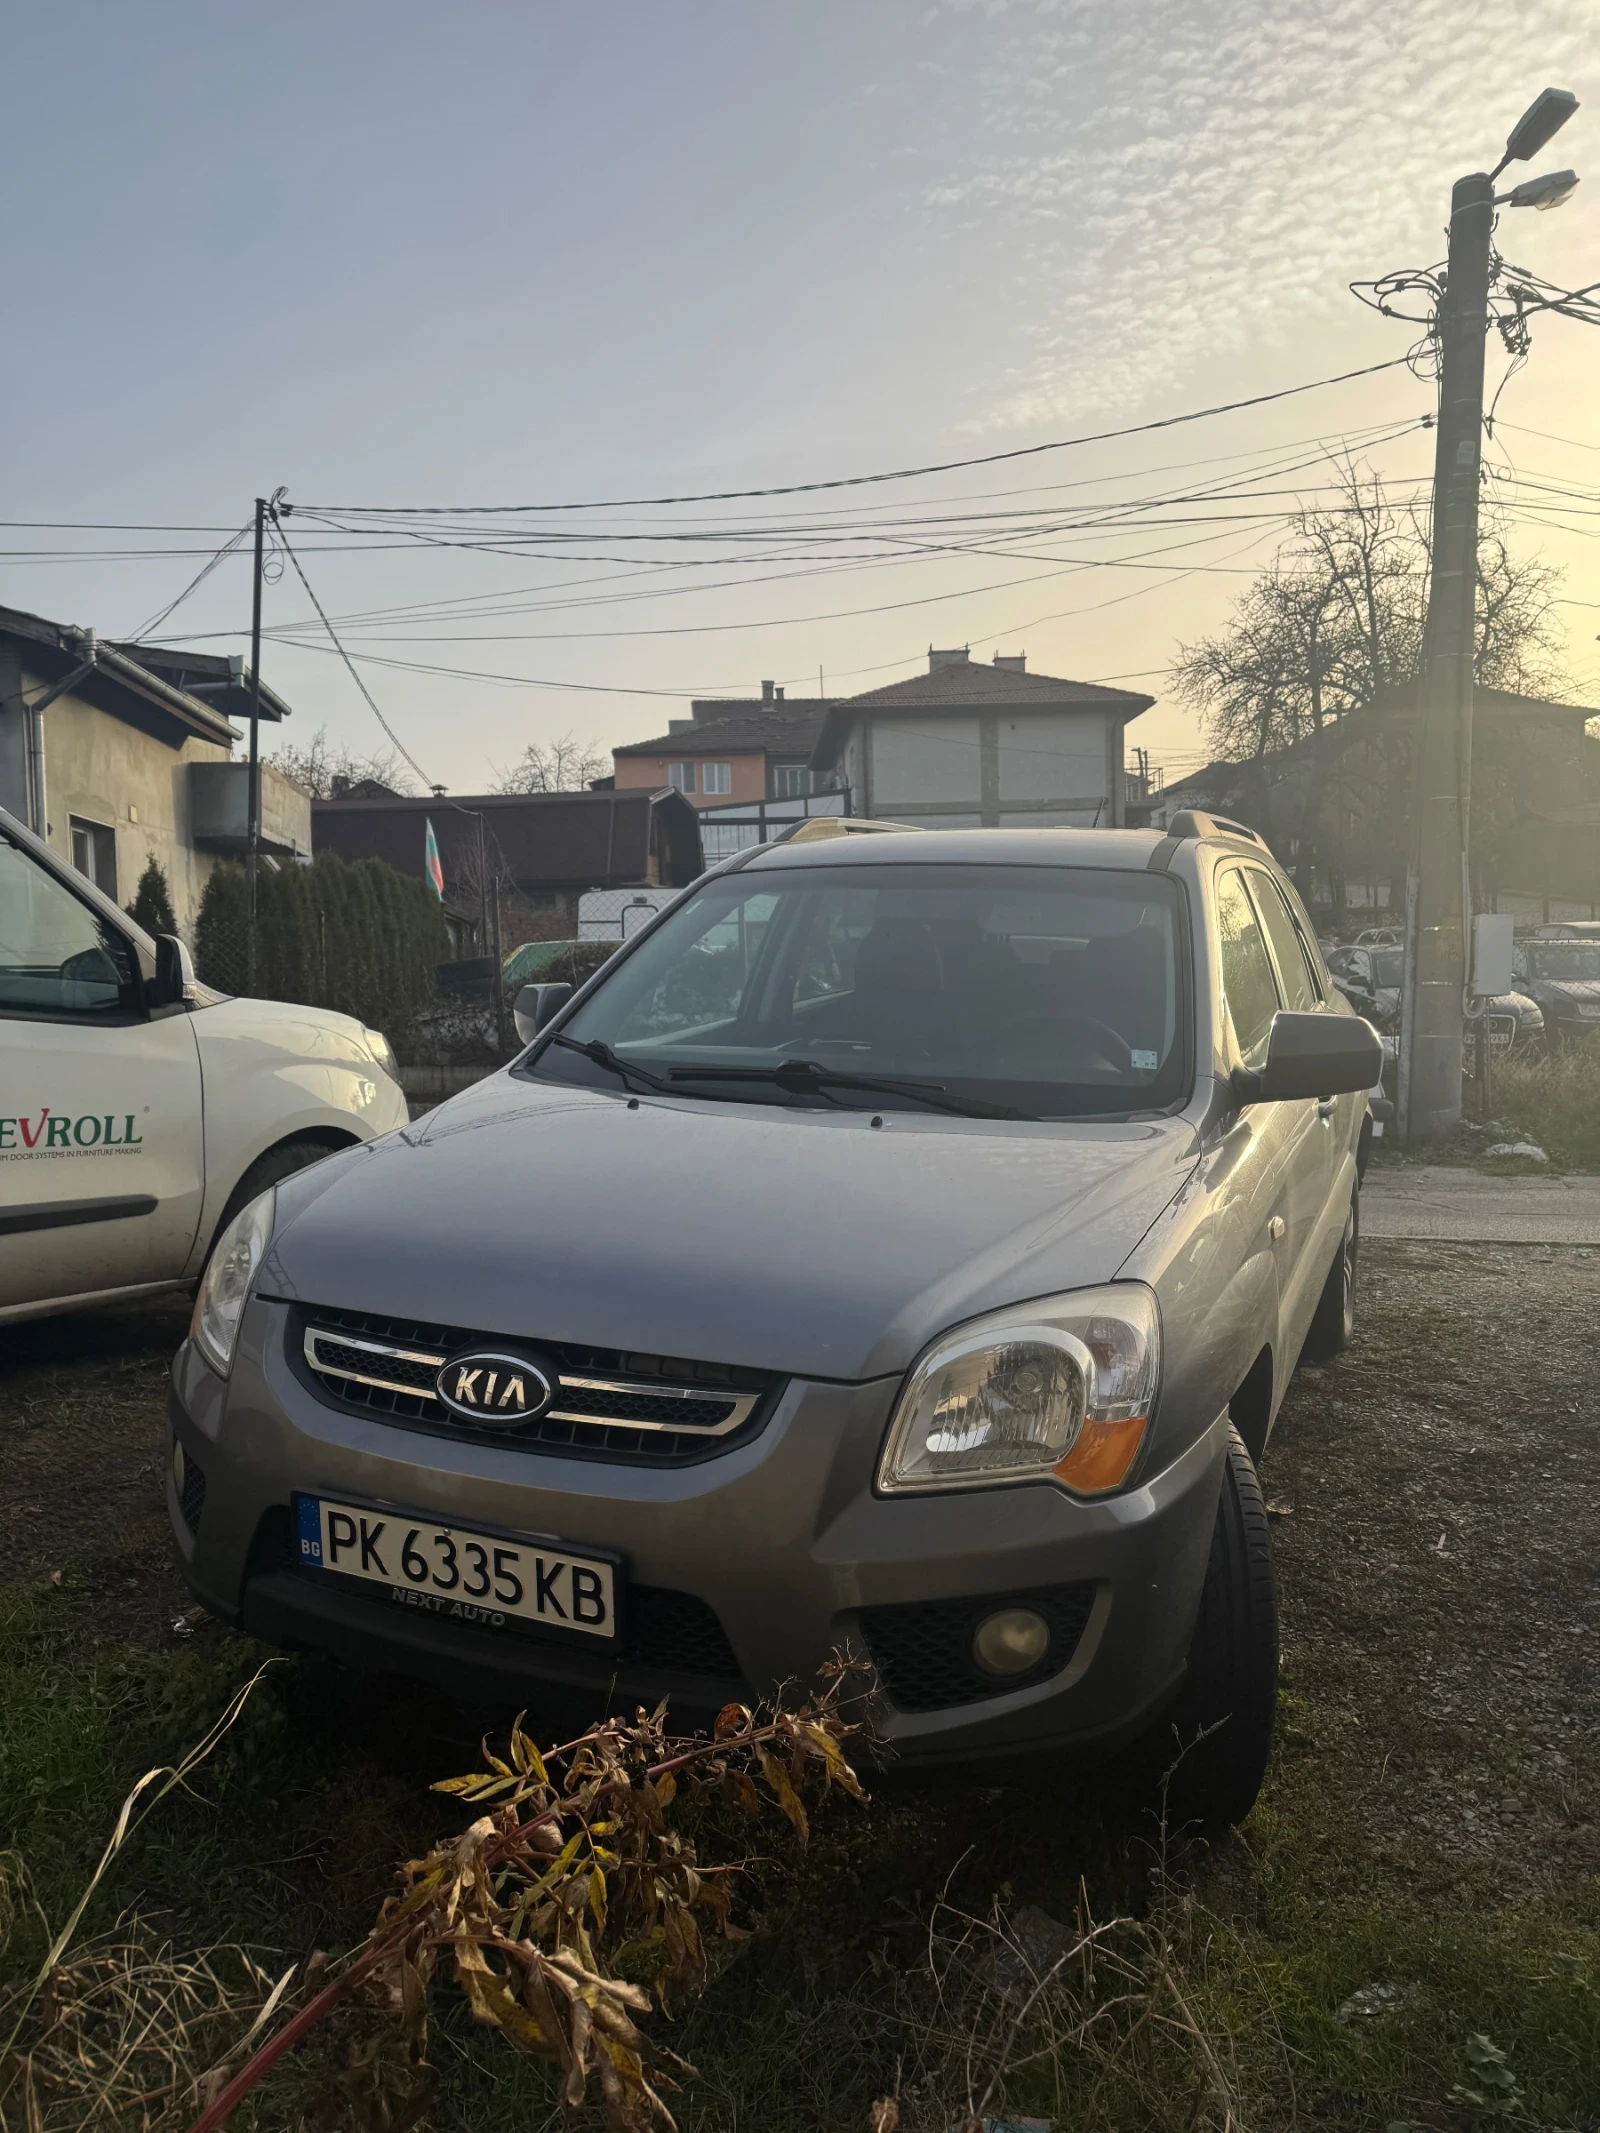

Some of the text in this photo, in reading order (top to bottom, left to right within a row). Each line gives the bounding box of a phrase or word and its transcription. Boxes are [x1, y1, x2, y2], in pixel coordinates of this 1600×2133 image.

[10, 1153, 34, 1161] DOOR
[35, 1151, 65, 1160] SYSTEMS
[76, 1148, 114, 1157] FURNITURE
[115, 1147, 142, 1155] MAKING
[455, 1366, 526, 1410] KIA
[301, 1539, 320, 1557] BG
[328, 1510, 606, 1626] PK 6335 KB
[392, 1587, 506, 1627] NEXT AUTO
